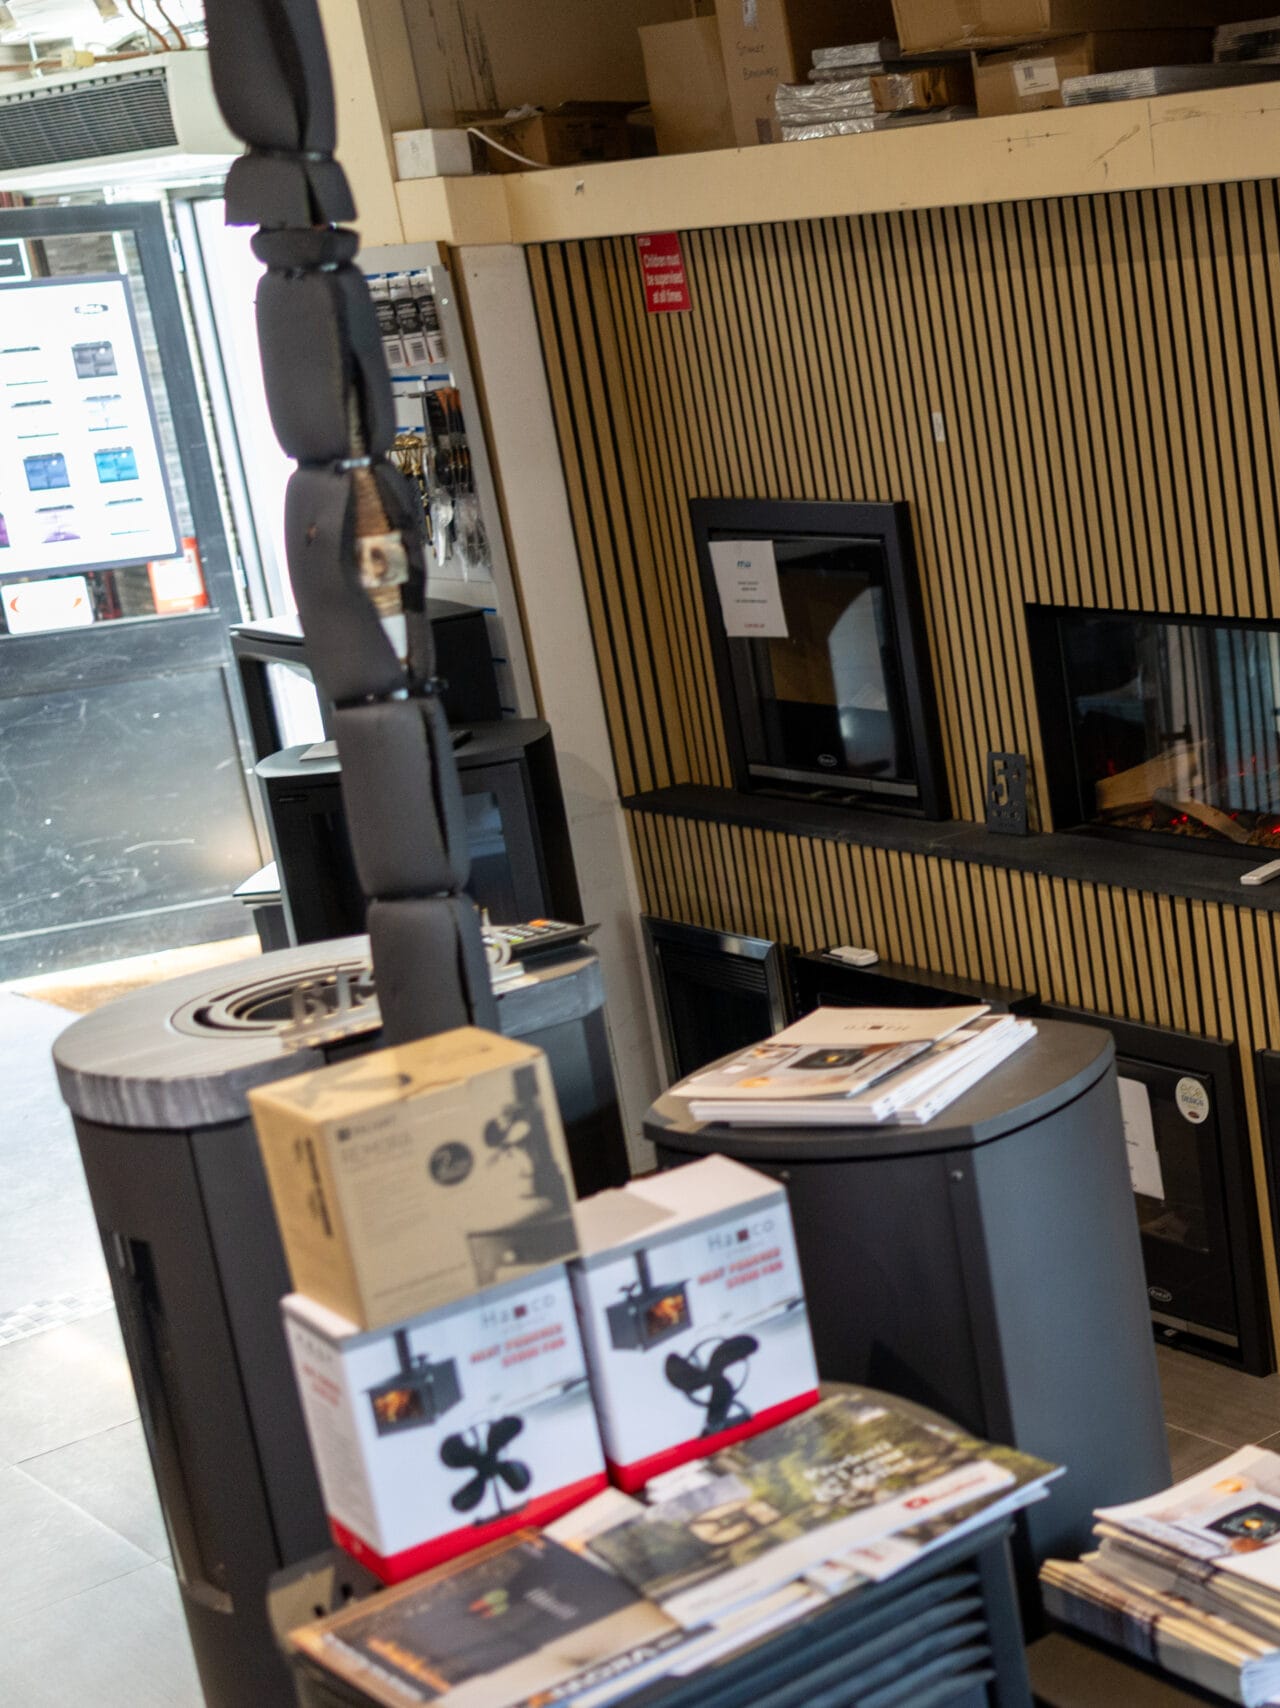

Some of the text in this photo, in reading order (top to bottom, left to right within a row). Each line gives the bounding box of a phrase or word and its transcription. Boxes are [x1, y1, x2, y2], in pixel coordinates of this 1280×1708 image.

[643, 253, 680, 268] Children must
[646, 270, 684, 288] be supervised
[666, 289, 683, 303] times
